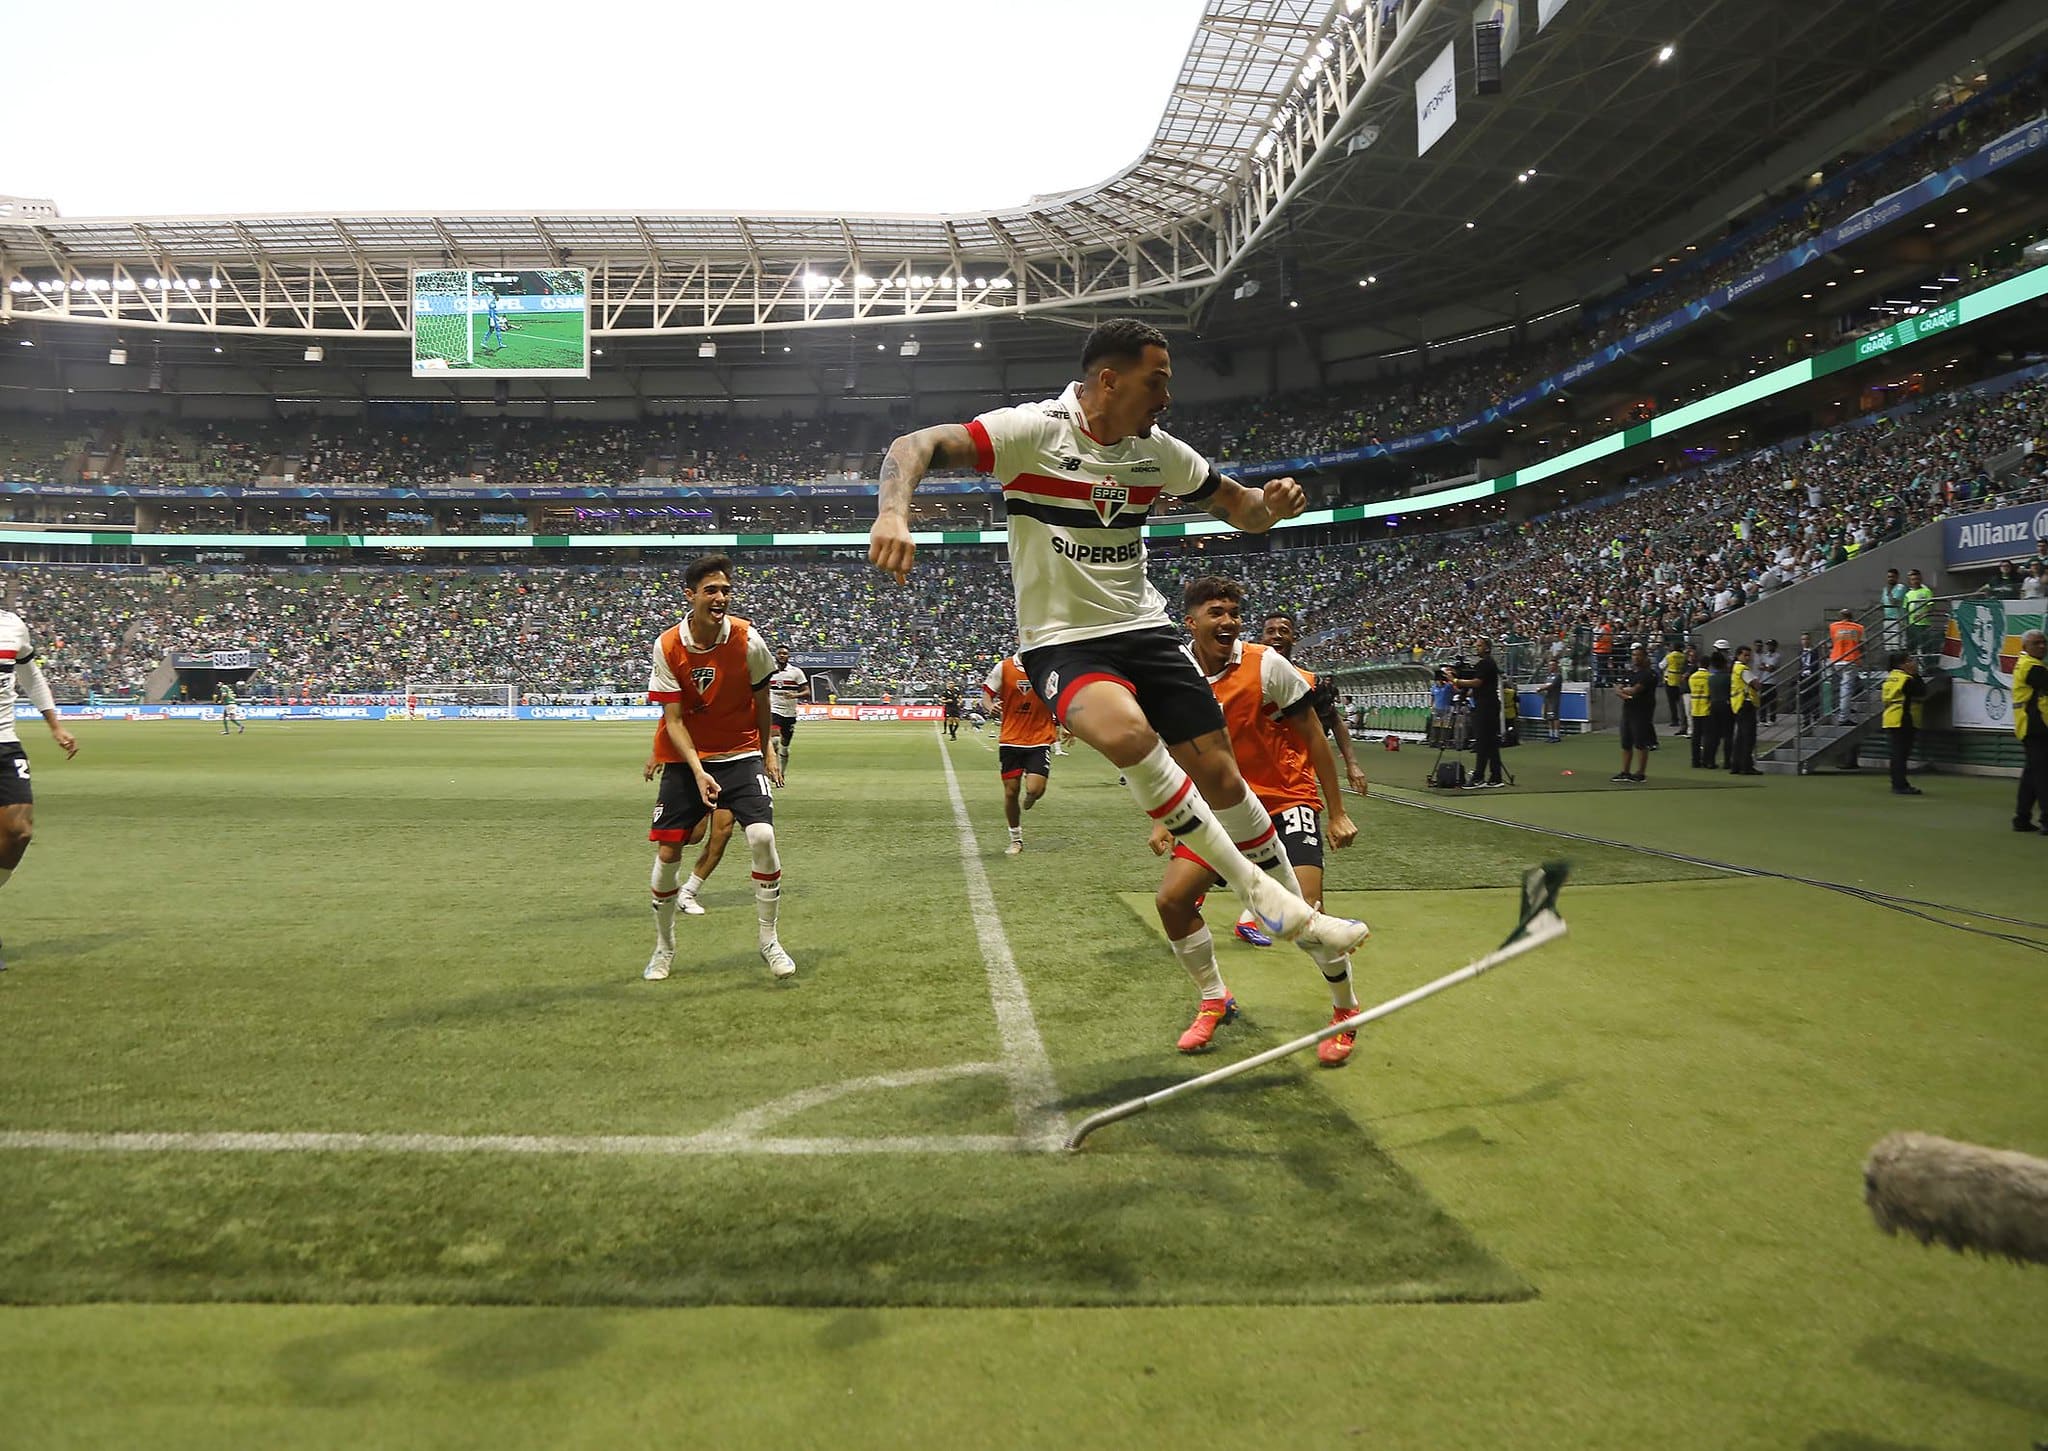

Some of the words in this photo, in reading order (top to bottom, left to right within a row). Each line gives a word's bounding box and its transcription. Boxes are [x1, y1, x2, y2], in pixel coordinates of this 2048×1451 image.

[1920, 310, 1957, 332] CRAQUE
[1861, 334, 1894, 354] CRAQUE
[1094, 488, 1126, 499] SPFC
[1958, 521, 2029, 549] Allianz
[323, 707, 370, 717] SAMPEL
[470, 707, 517, 717] SAMPEL
[544, 707, 591, 718] SAMPEL
[1281, 806, 1317, 835] 39
